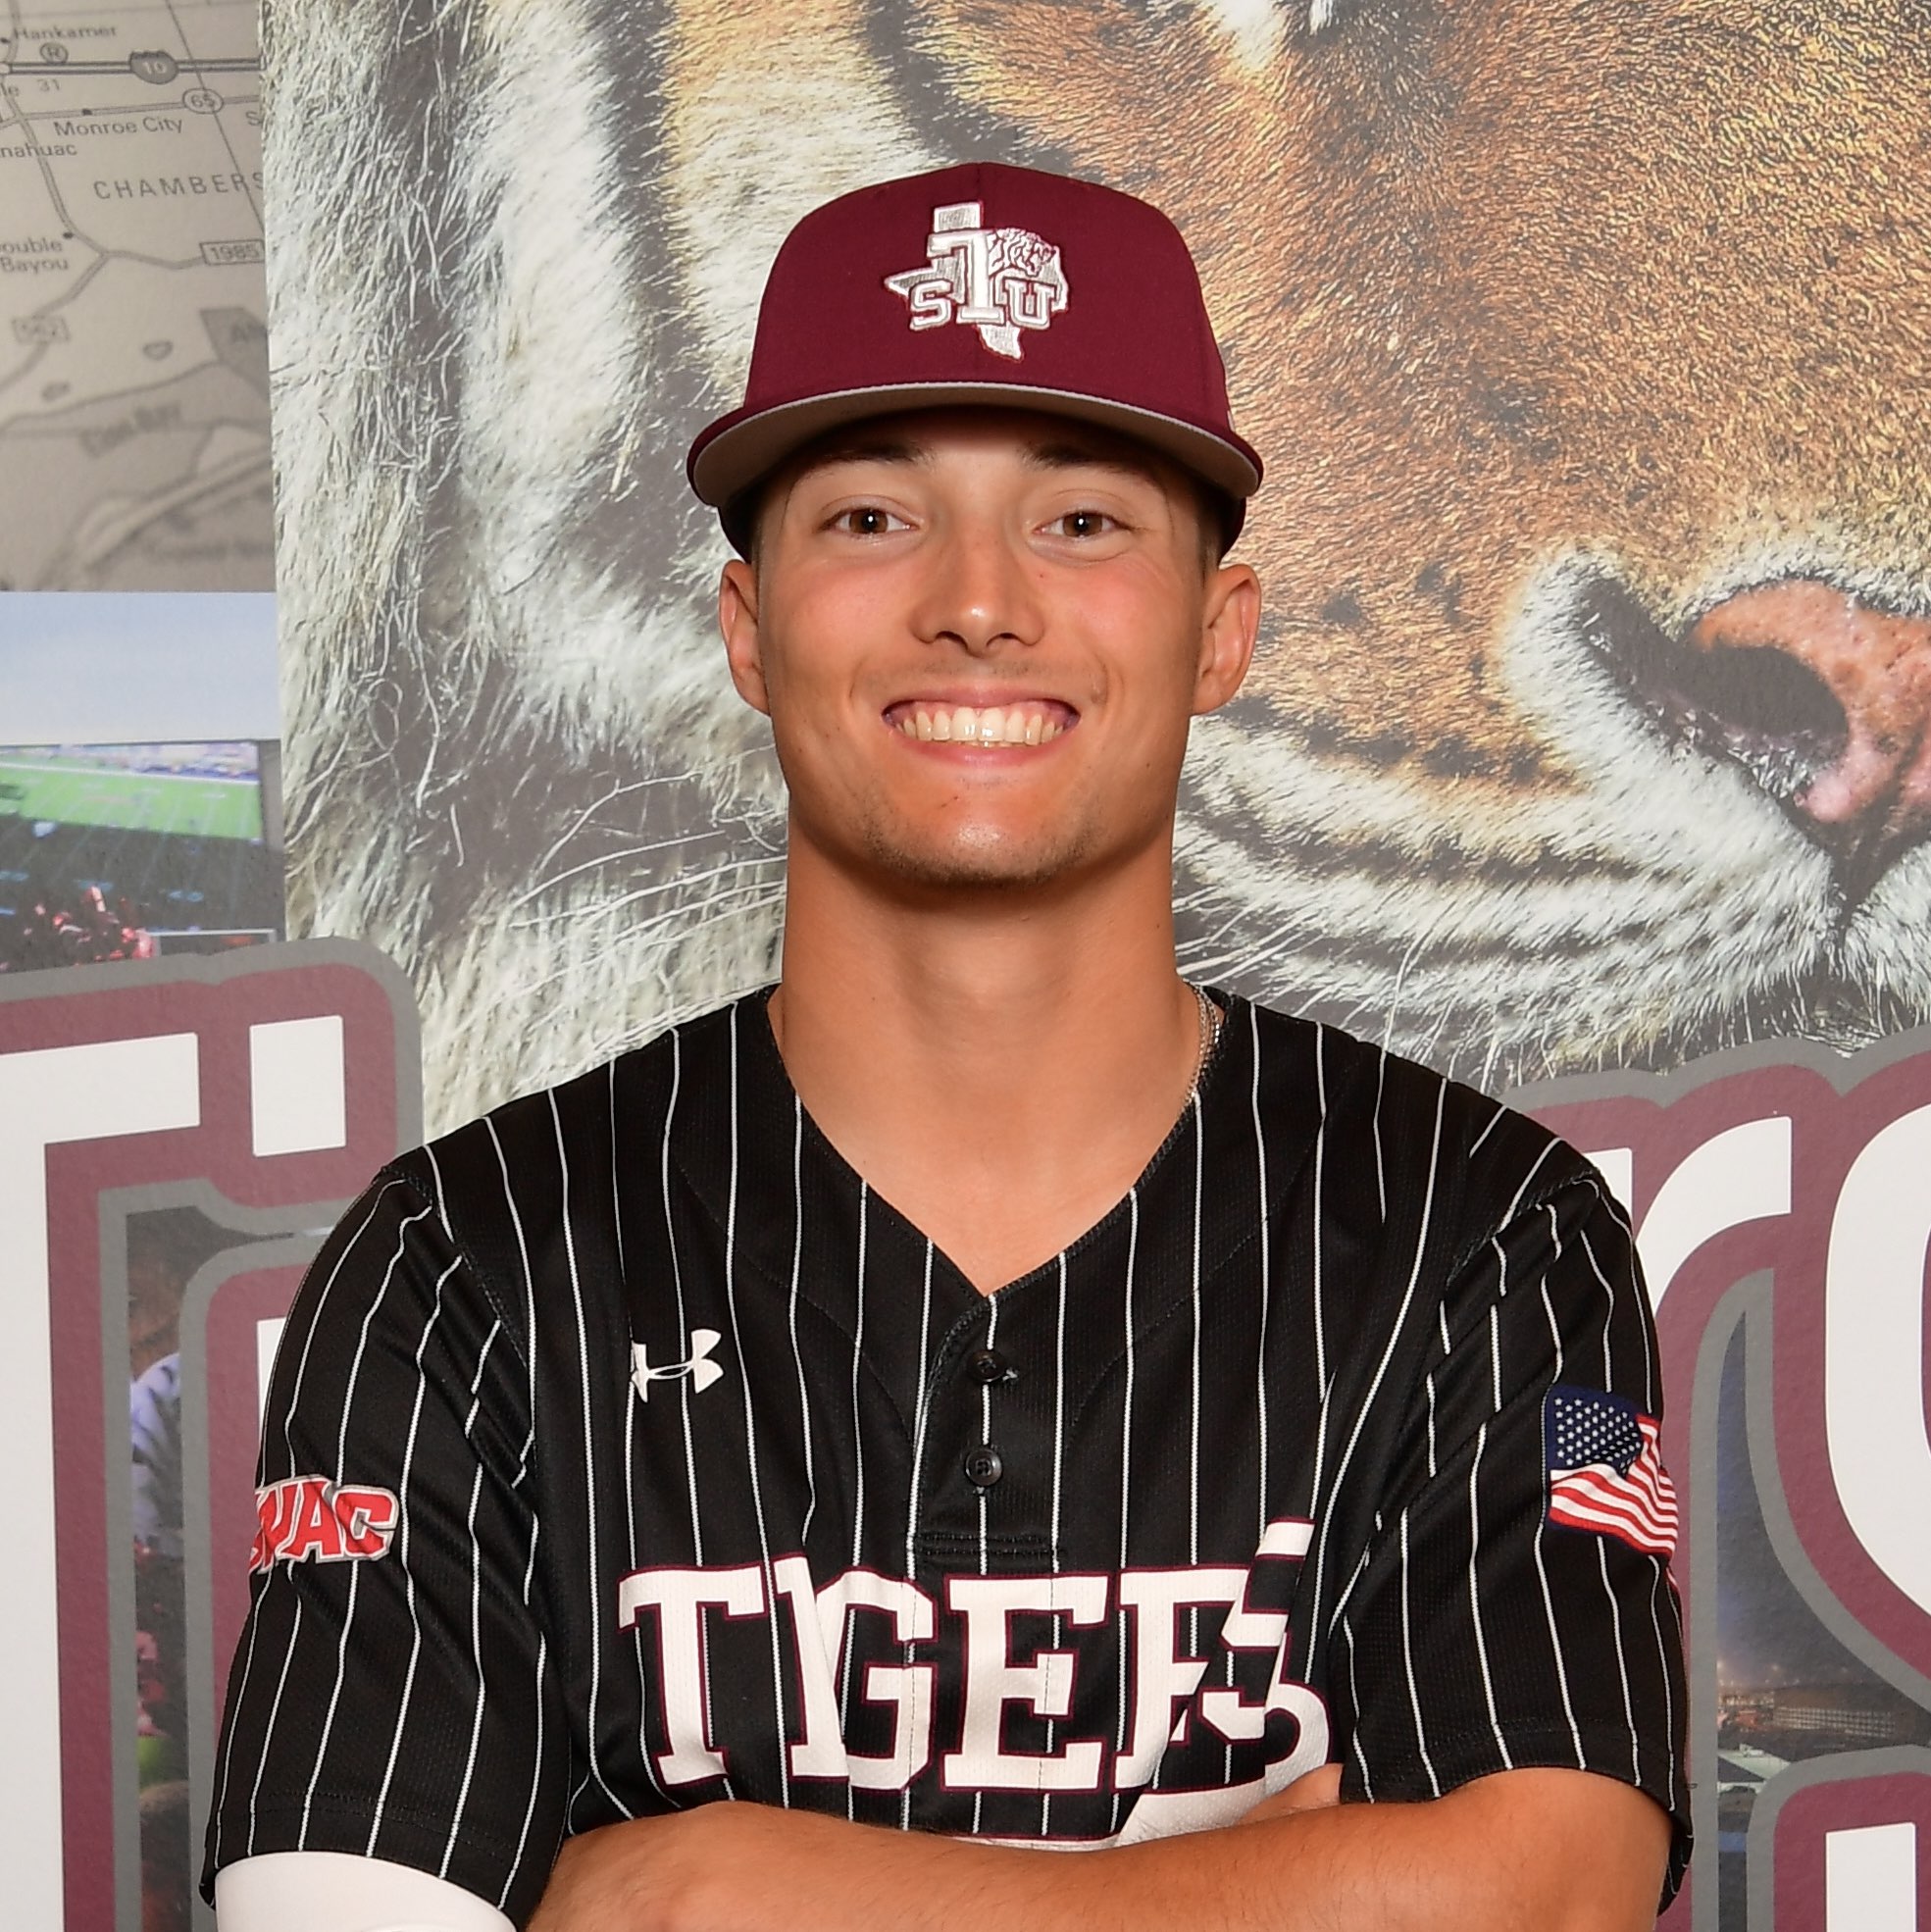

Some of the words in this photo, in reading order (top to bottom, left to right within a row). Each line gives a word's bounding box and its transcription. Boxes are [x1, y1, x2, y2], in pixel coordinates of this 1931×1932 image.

[53, 120, 137, 137] Monroe
[142, 116, 183, 134] City
[93, 171, 263, 200] CHAMBERS
[210, 244, 260, 261] 1985
[0, 256, 69, 275] Bayou
[249, 1474, 399, 1575] WAC
